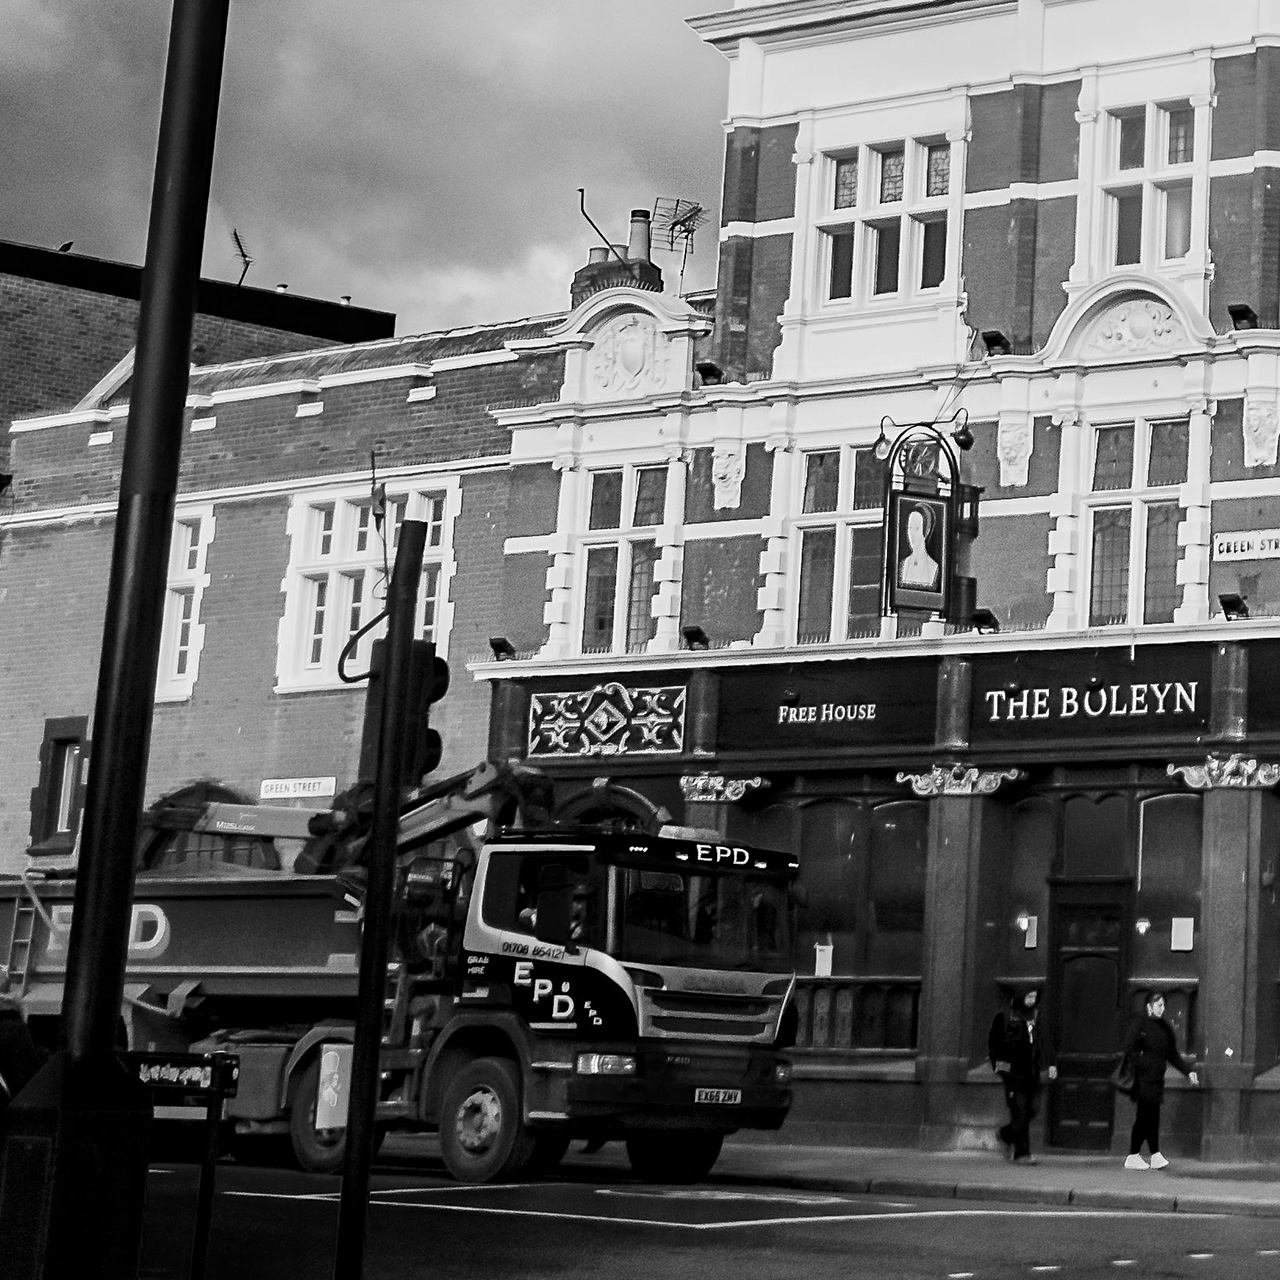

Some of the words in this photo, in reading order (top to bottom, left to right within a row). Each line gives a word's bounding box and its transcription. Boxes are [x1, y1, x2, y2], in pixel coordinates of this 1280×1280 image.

[1218, 541, 1254, 554] GREEN
[985, 688, 1050, 720] THE
[1060, 682, 1198, 717] BOLEYN
[779, 706, 817, 723] FREE
[821, 703, 876, 721] HOUSE
[264, 783, 290, 794] GREEN
[293, 781, 322, 793] STREET
[697, 844, 750, 865] EPD
[502, 942, 529, 955] 01708
[467, 956, 490, 964] GRAB
[467, 966, 486, 974] HIRE
